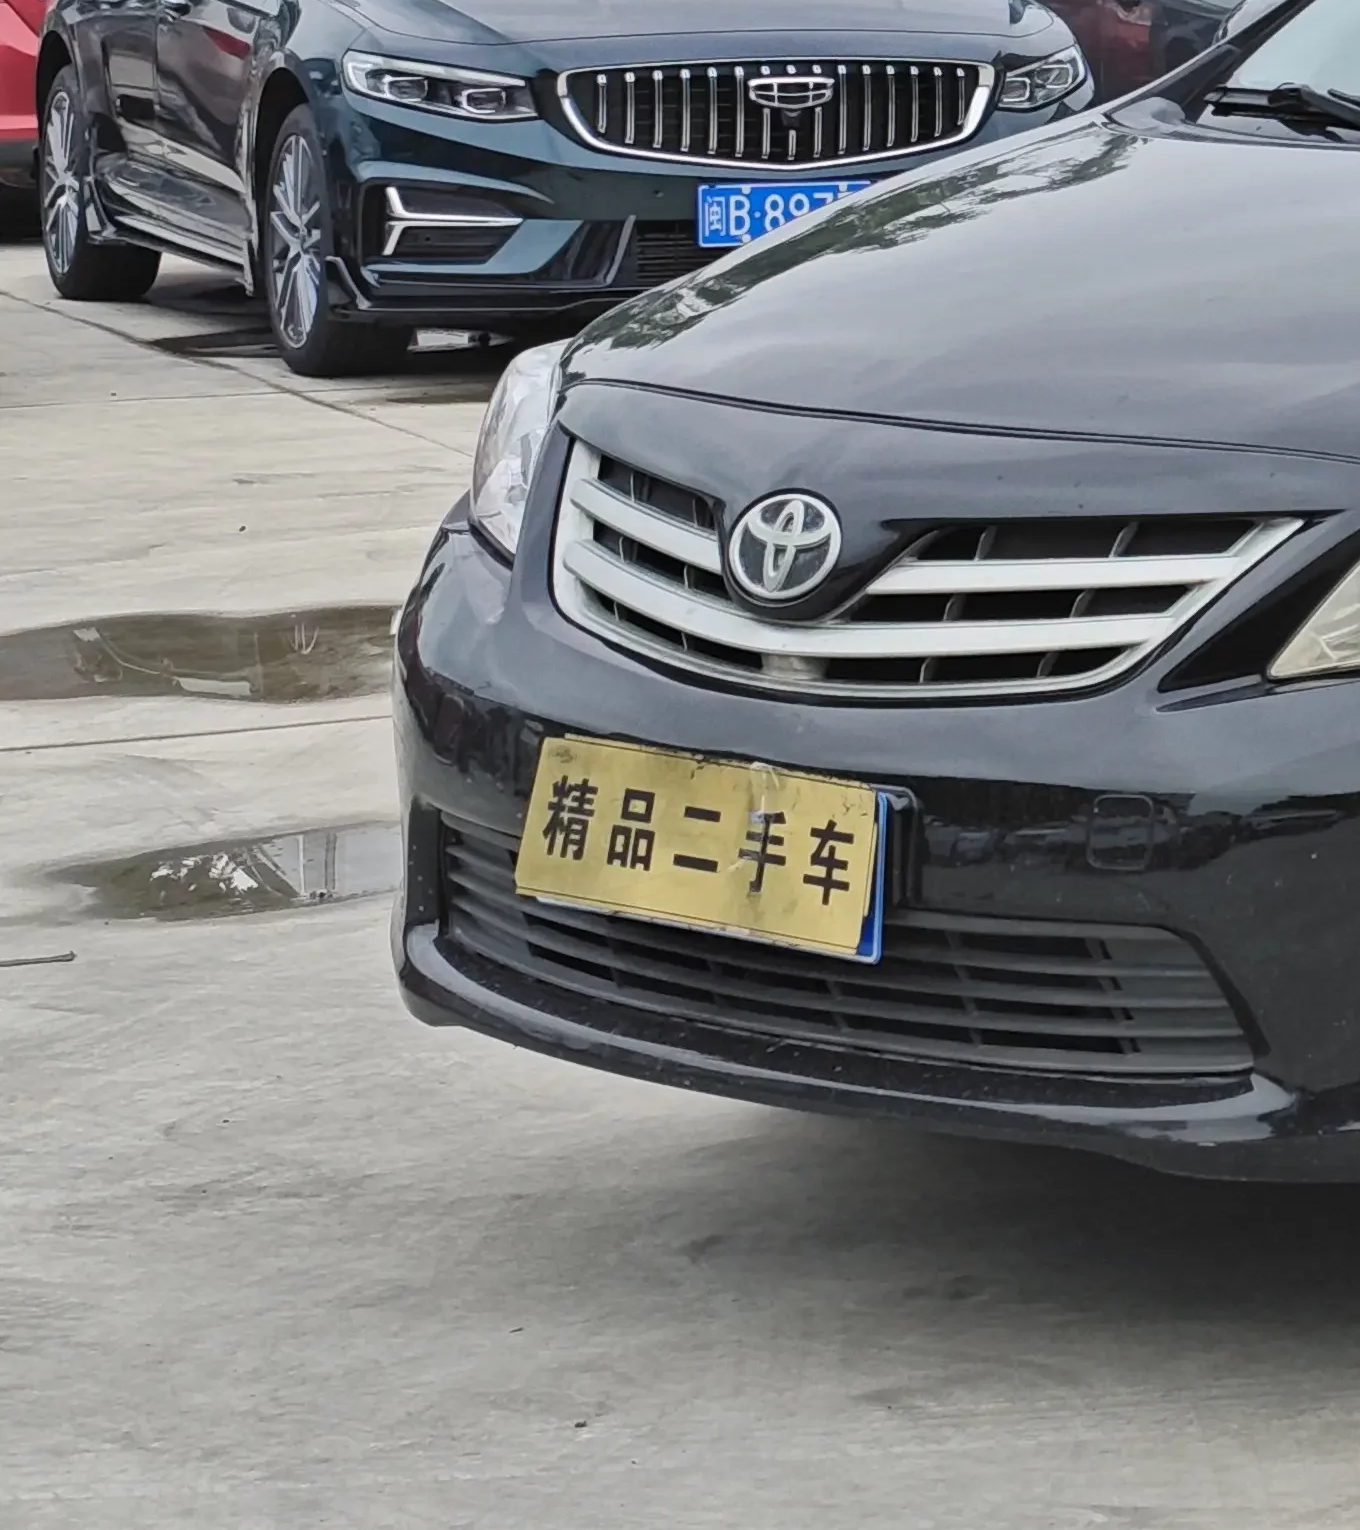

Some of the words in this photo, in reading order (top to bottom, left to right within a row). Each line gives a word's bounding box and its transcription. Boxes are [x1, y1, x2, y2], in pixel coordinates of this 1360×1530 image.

[542, 775, 855, 906] 精品二手车
